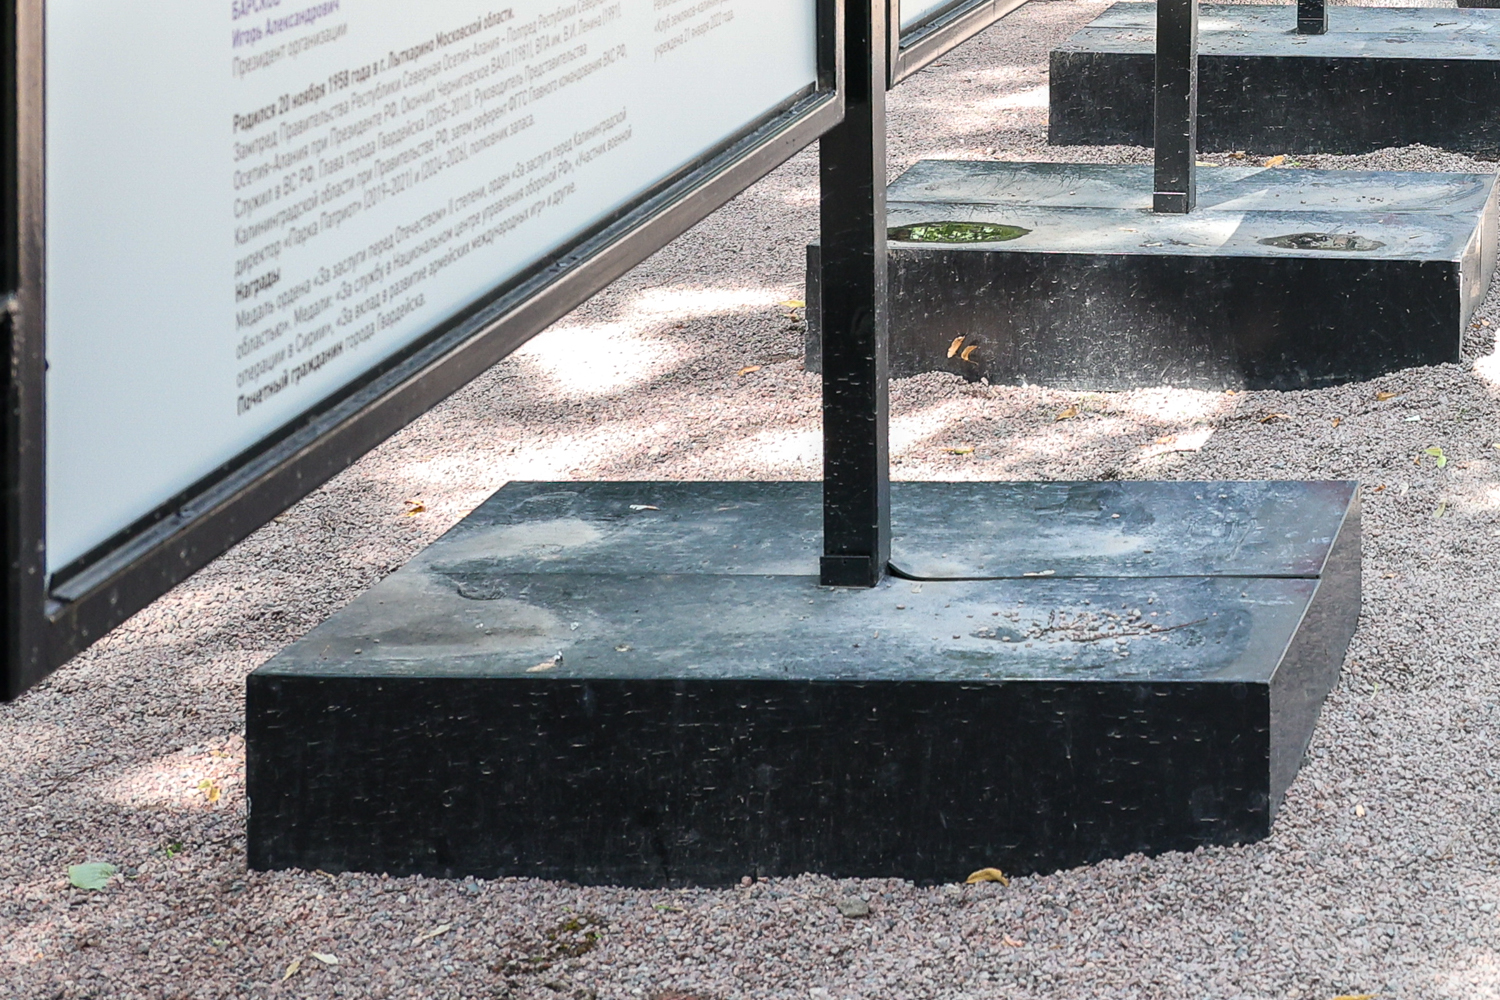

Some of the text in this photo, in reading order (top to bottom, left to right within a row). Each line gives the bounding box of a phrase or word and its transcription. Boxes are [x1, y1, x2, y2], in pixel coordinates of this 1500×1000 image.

[231, 23, 263, 49] Игорь
[231, 43, 285, 81] Президент
[232, 101, 276, 133] Родился
[291, 81, 326, 109] ноября
[351, 63, 371, 85] года
[387, 38, 434, 70] Лыткарино
[436, 15, 482, 50] Московской
[483, 7, 515, 30] области.
[233, 129, 277, 162] Зампред
[279, 98, 349, 145] Правительства
[350, 77, 401, 112] Республики
[235, 266, 280, 304] Награды
[236, 297, 274, 332] Медаль
[237, 366, 288, 417] Почетный
[290, 339, 343, 385] гражданин
